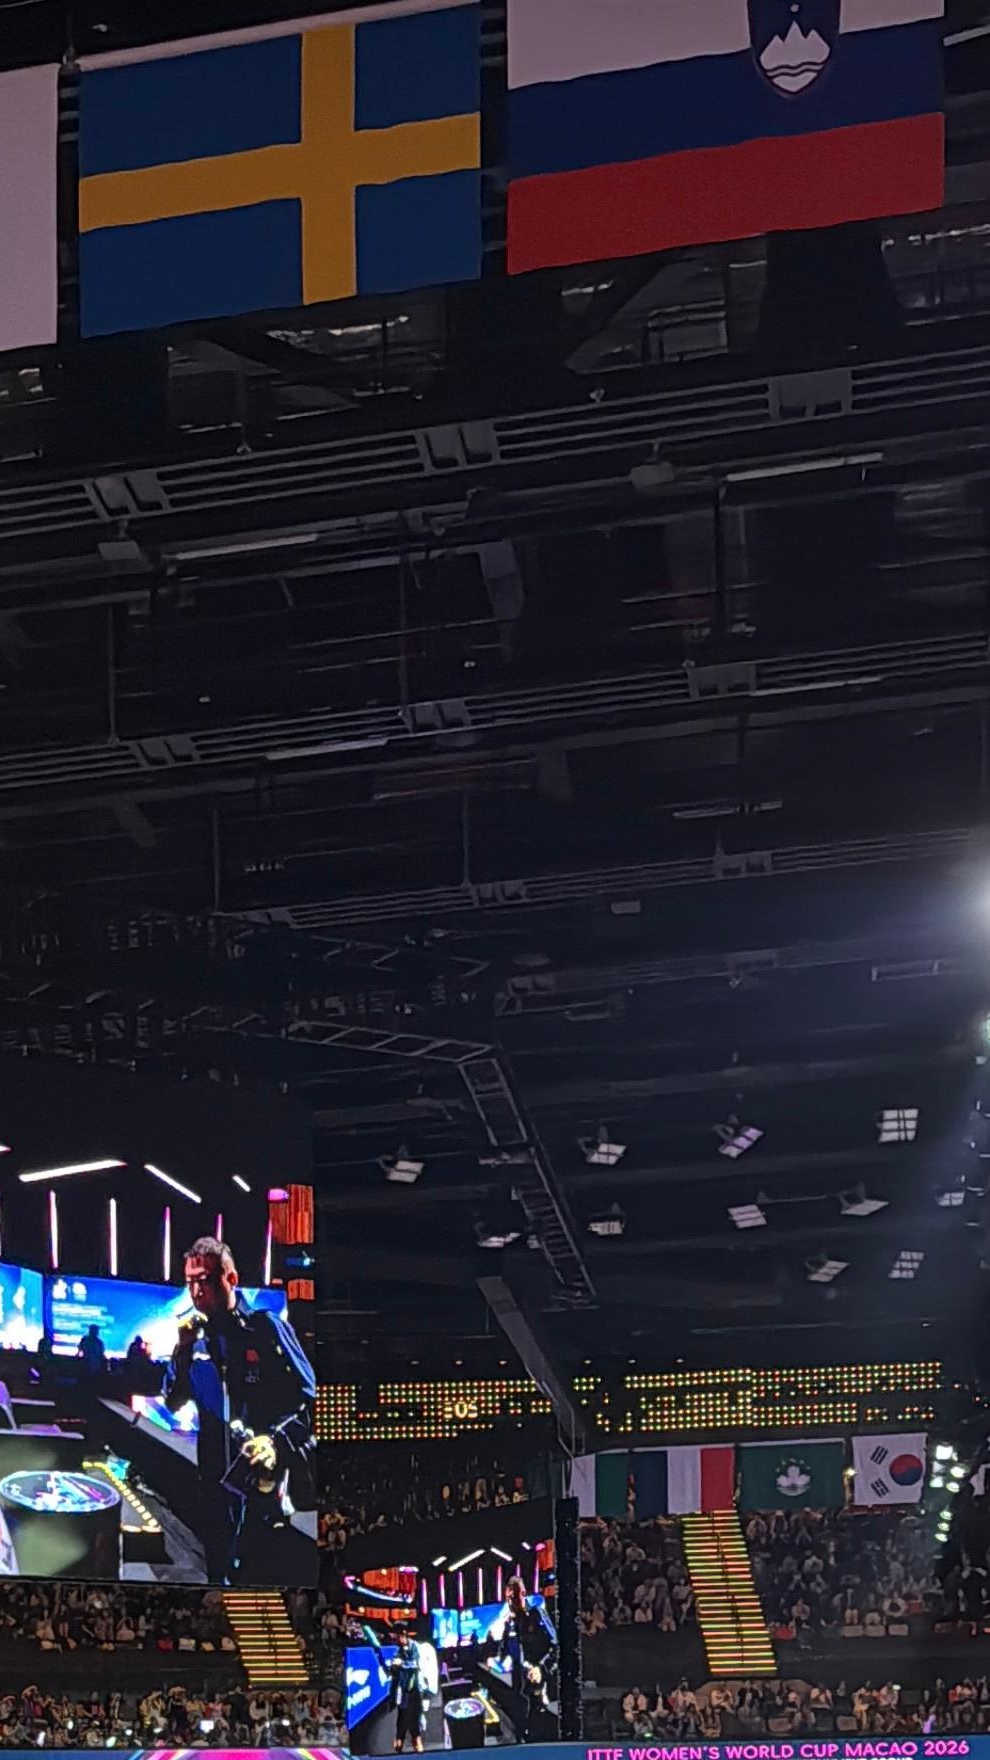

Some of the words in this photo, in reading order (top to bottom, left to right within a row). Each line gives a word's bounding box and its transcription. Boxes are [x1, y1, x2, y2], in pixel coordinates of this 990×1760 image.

[725, 1744, 794, 1760] WORLD
[800, 1743, 839, 1758] CUP
[845, 1741, 918, 1757] MACAO
[924, 1740, 970, 1756] 2026
